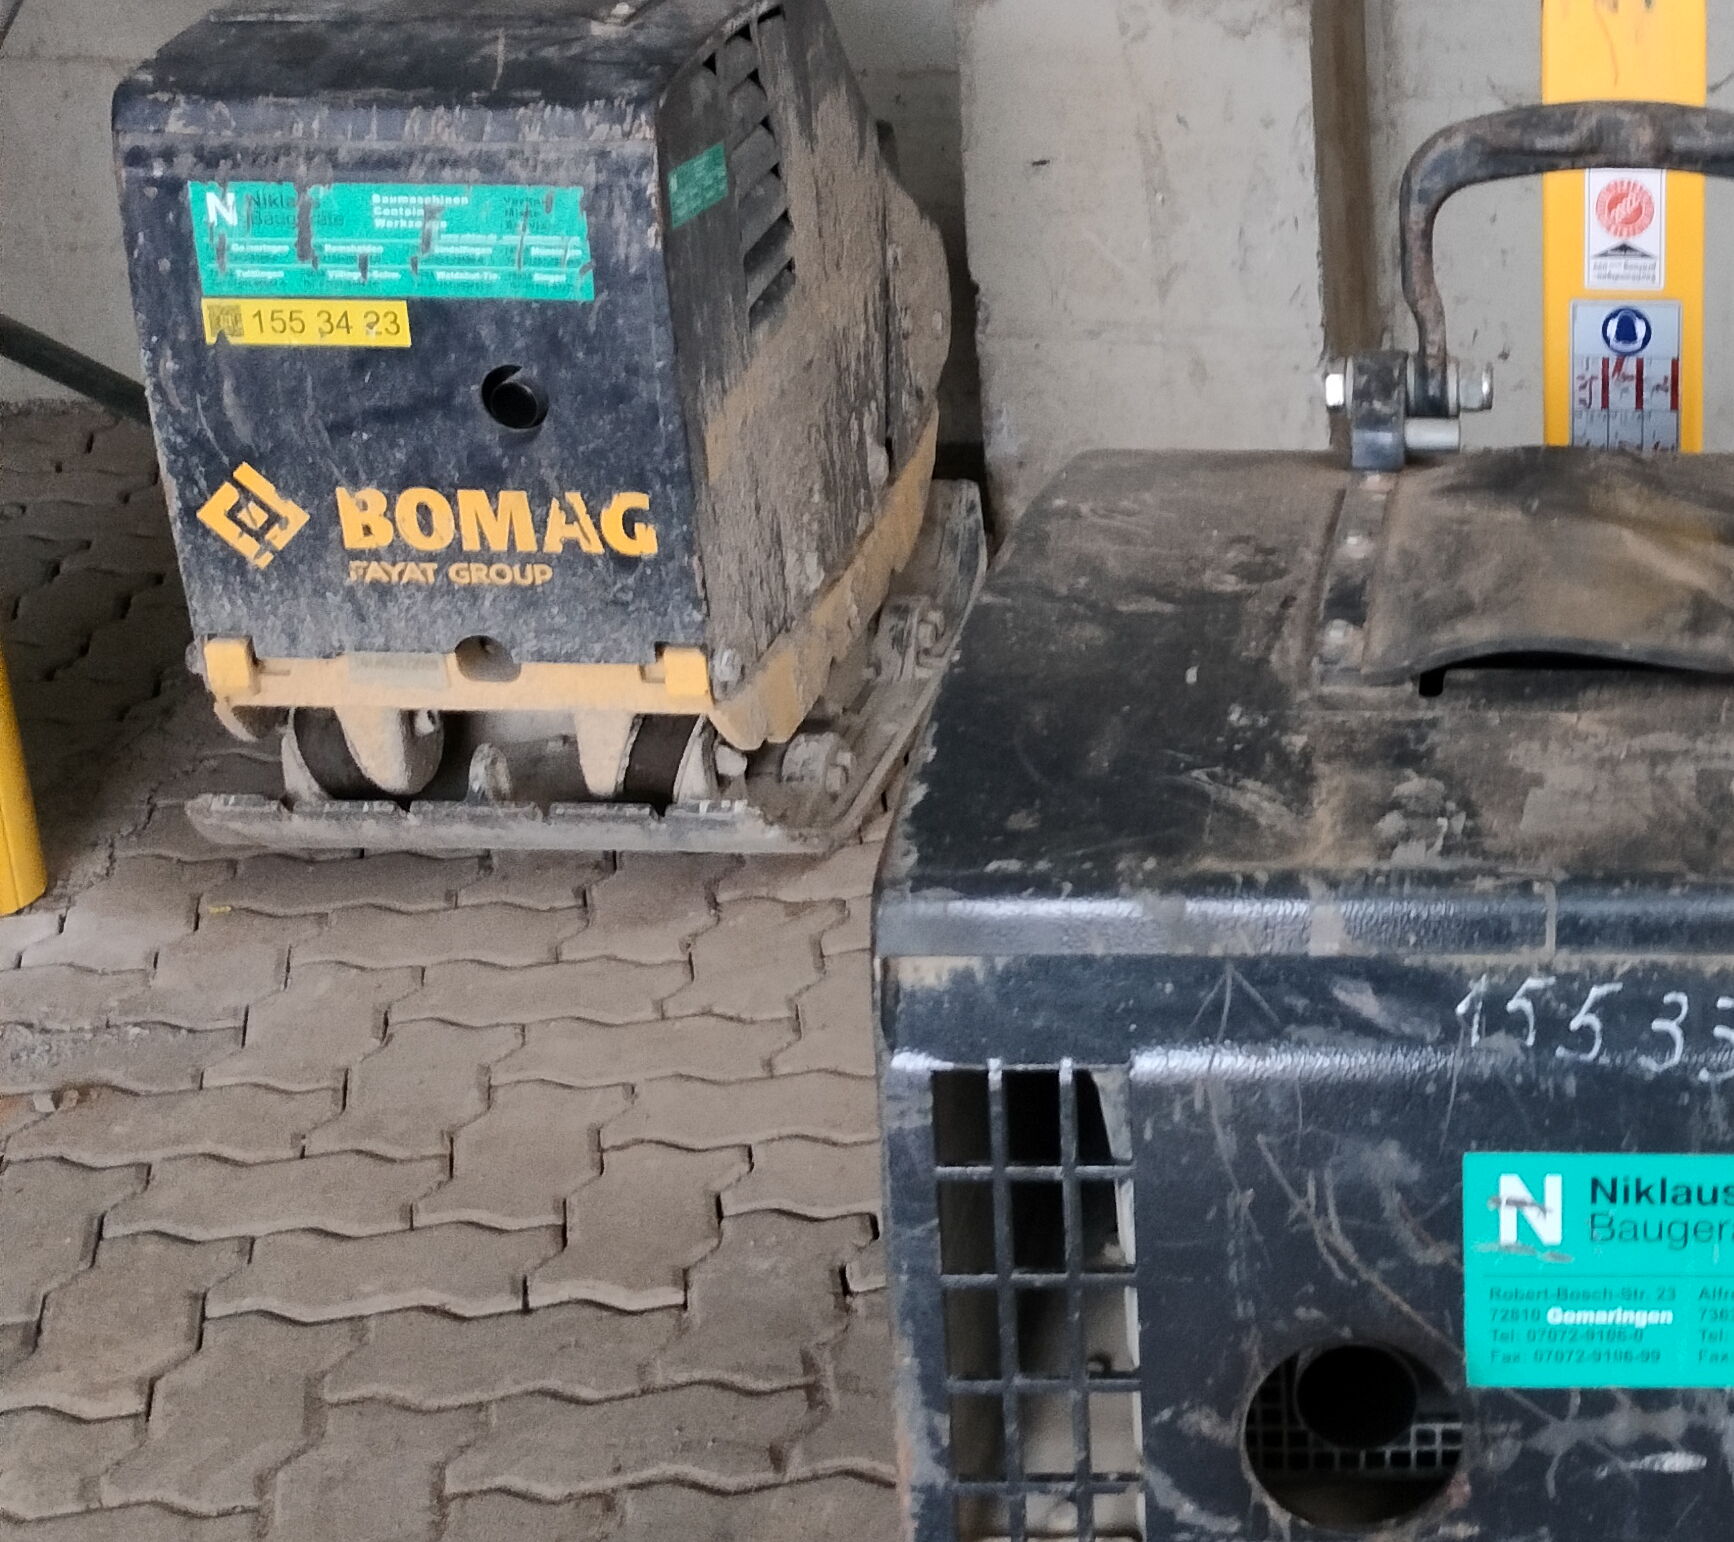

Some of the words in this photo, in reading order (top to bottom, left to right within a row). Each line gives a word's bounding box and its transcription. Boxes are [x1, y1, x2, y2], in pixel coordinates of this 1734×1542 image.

[206, 192, 238, 226] N
[252, 310, 305, 334] 155
[317, 310, 353, 335] 34
[363, 311, 400, 336] 23
[336, 487, 658, 556] BOMAG
[349, 561, 438, 585] FAYAT
[448, 562, 553, 586] GROUP
[1499, 1173, 1562, 1245] N
[1489, 1286, 1652, 1302] Robert-Bosch-Str.
